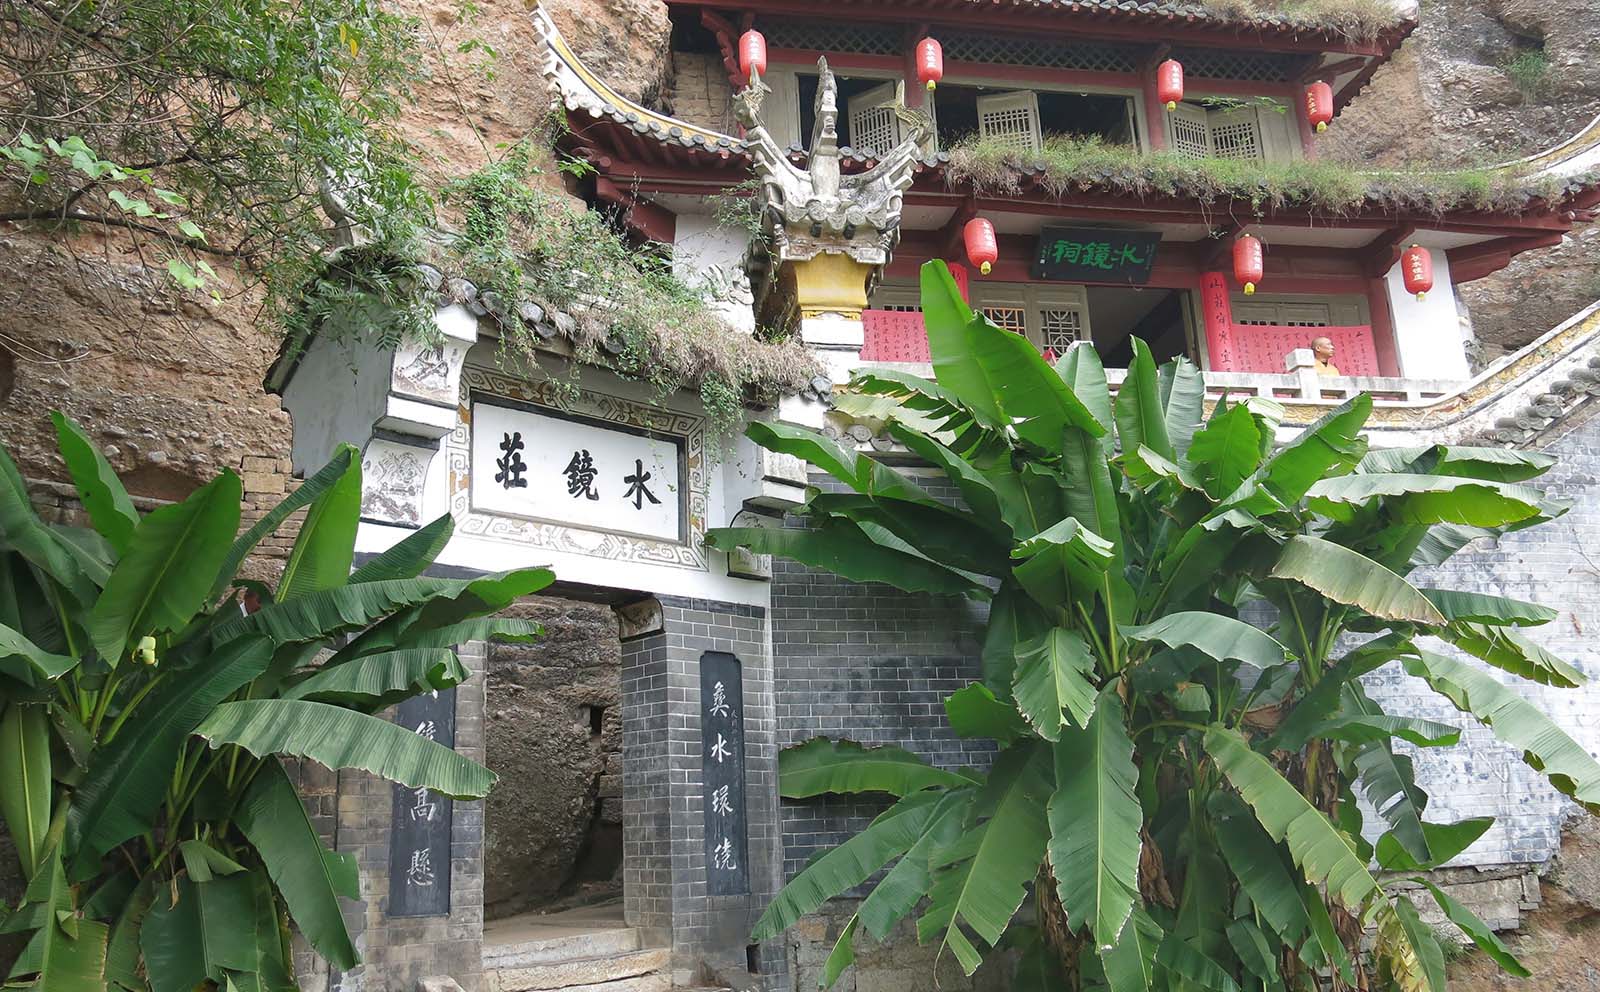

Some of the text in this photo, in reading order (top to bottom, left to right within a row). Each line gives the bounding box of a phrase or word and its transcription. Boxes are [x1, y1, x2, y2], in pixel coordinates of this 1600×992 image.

[1053, 240, 1144, 269] 水鏡祠
[495, 432, 662, 510] 水鏡莊
